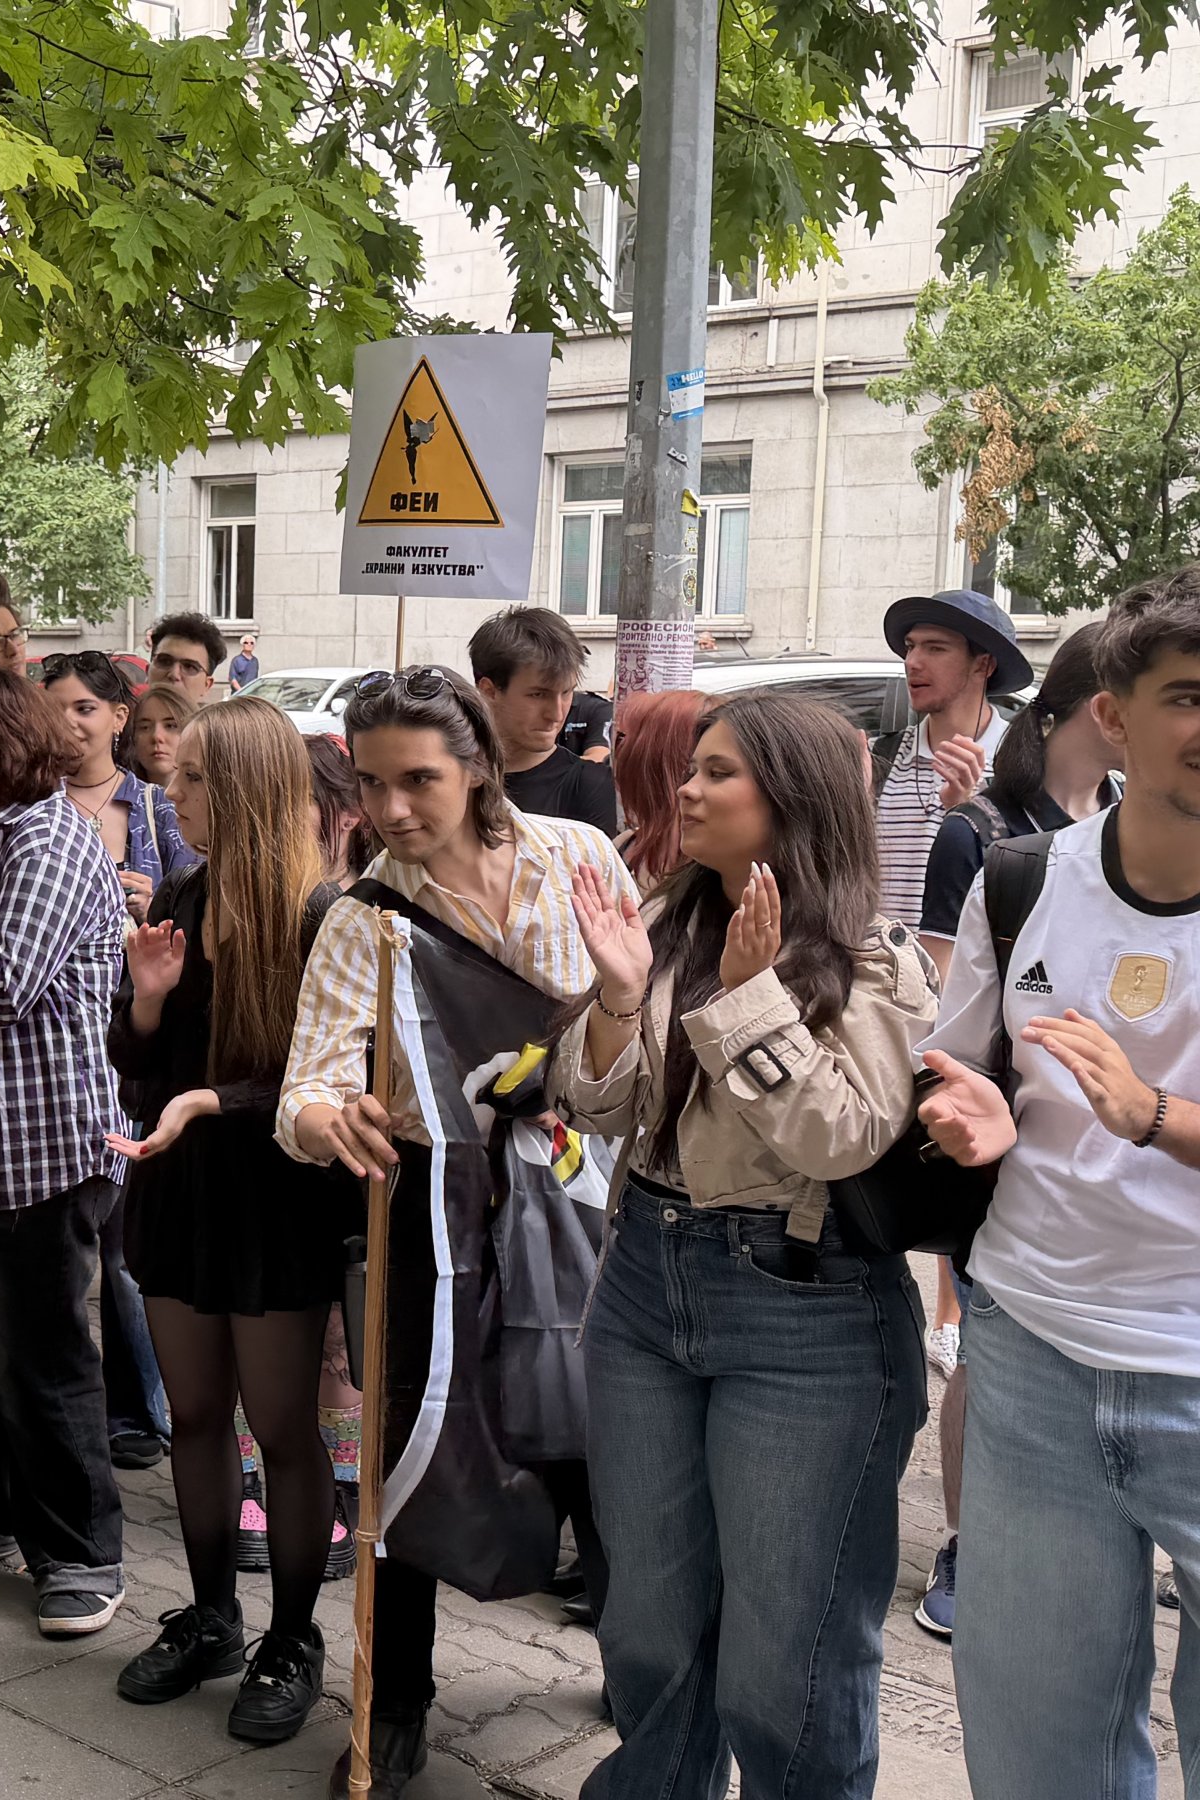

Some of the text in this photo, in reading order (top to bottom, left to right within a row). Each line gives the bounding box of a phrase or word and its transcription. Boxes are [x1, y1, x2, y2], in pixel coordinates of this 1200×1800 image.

[390, 492, 439, 513] ФЕИ
[386, 545, 450, 558] ФАКУЛТЕТ
[1015, 979, 1054, 994] adidas
